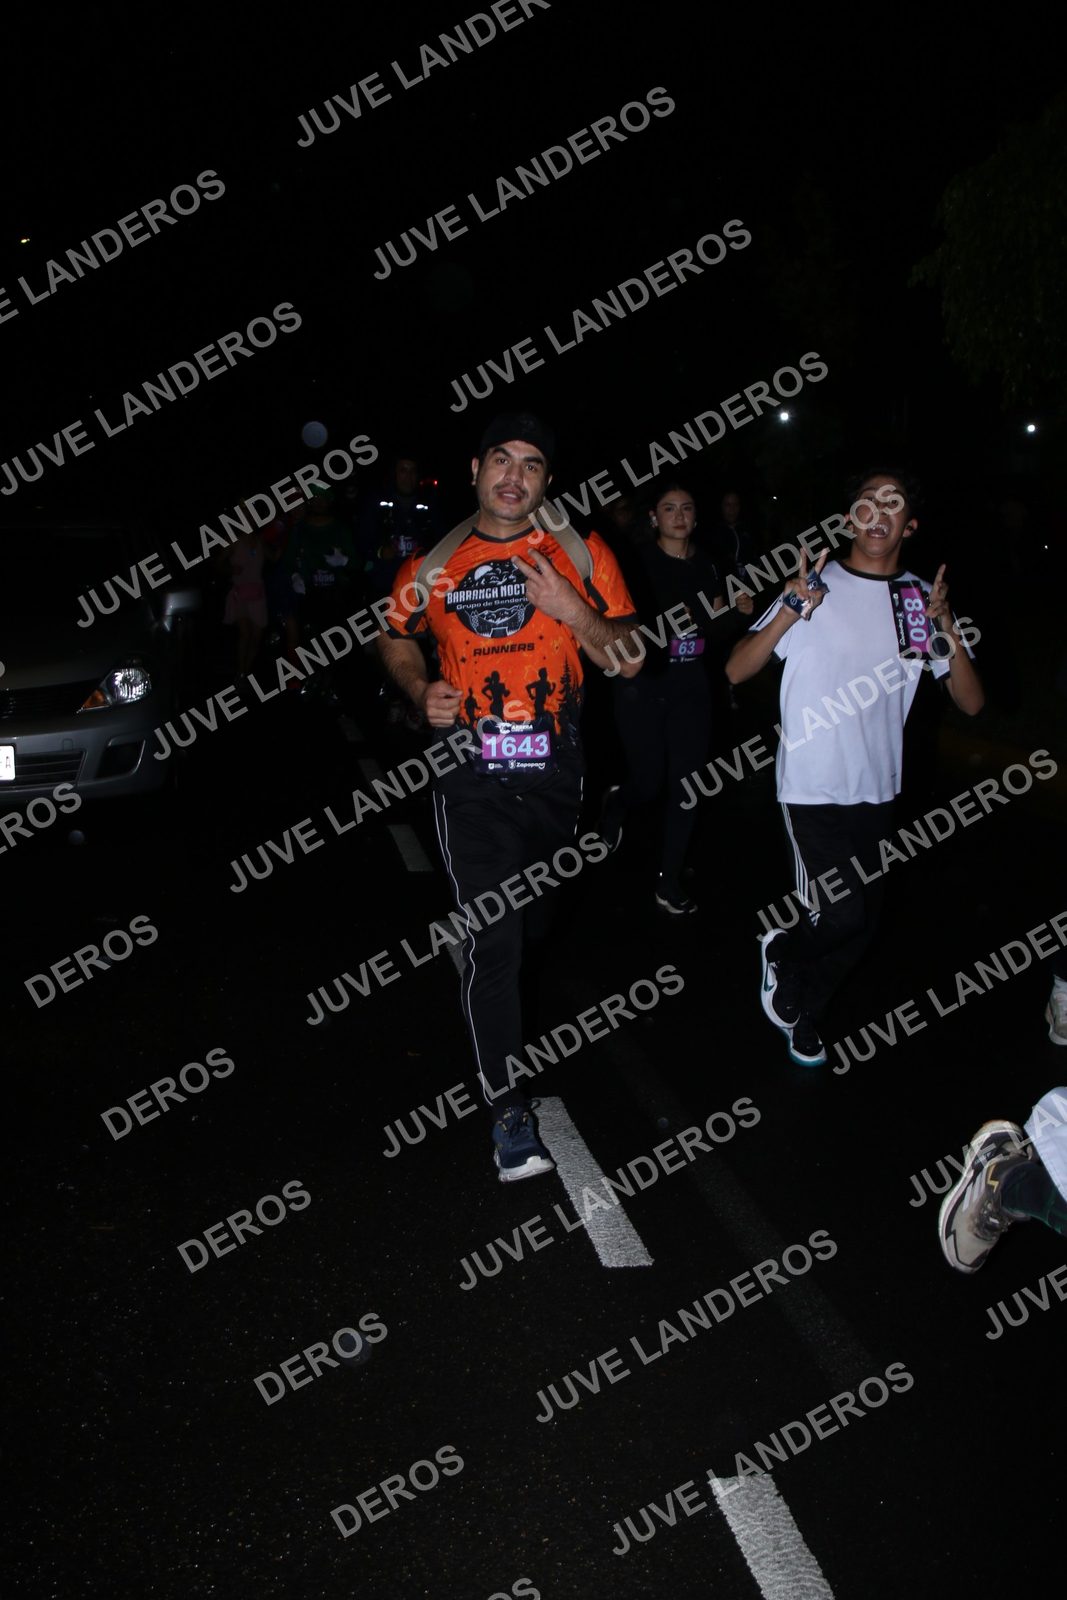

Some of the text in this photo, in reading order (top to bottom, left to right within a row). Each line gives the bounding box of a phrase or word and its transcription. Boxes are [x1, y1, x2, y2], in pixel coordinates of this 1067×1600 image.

[447, 587, 499, 605] BARRANCA
[456, 602, 482, 611] Grupo
[904, 598, 927, 642] 830
[473, 643, 535, 656] RUNNERS
[679, 641, 696, 655] 63
[486, 735, 549, 757] 1643
